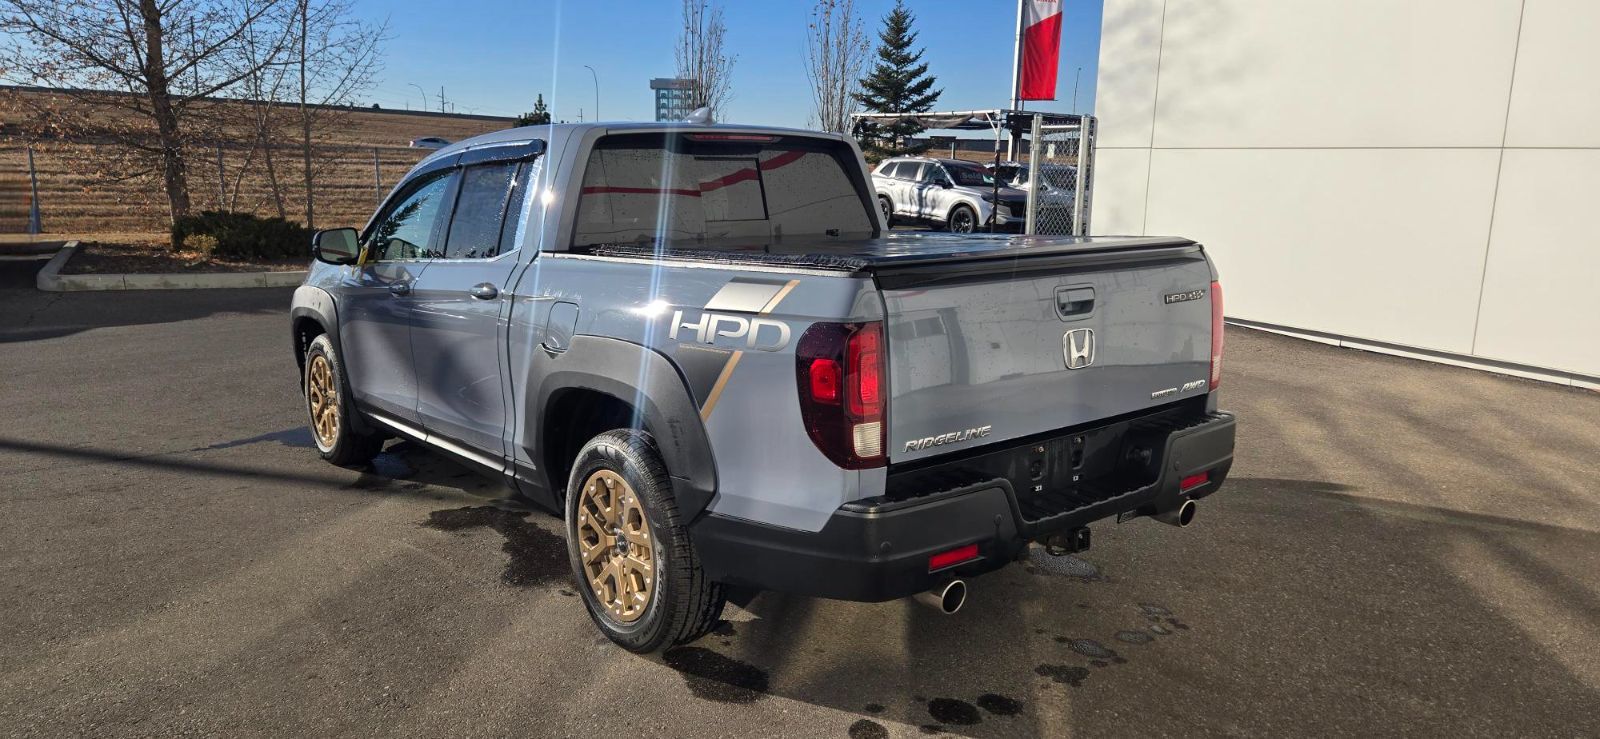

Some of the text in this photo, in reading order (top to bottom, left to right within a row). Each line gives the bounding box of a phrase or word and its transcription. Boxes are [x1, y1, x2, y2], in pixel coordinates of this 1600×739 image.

[1166, 293, 1187, 303] HPD
[669, 311, 791, 352] HPD
[1180, 379, 1206, 393] AWD
[903, 425, 992, 452] RIDGELINE
